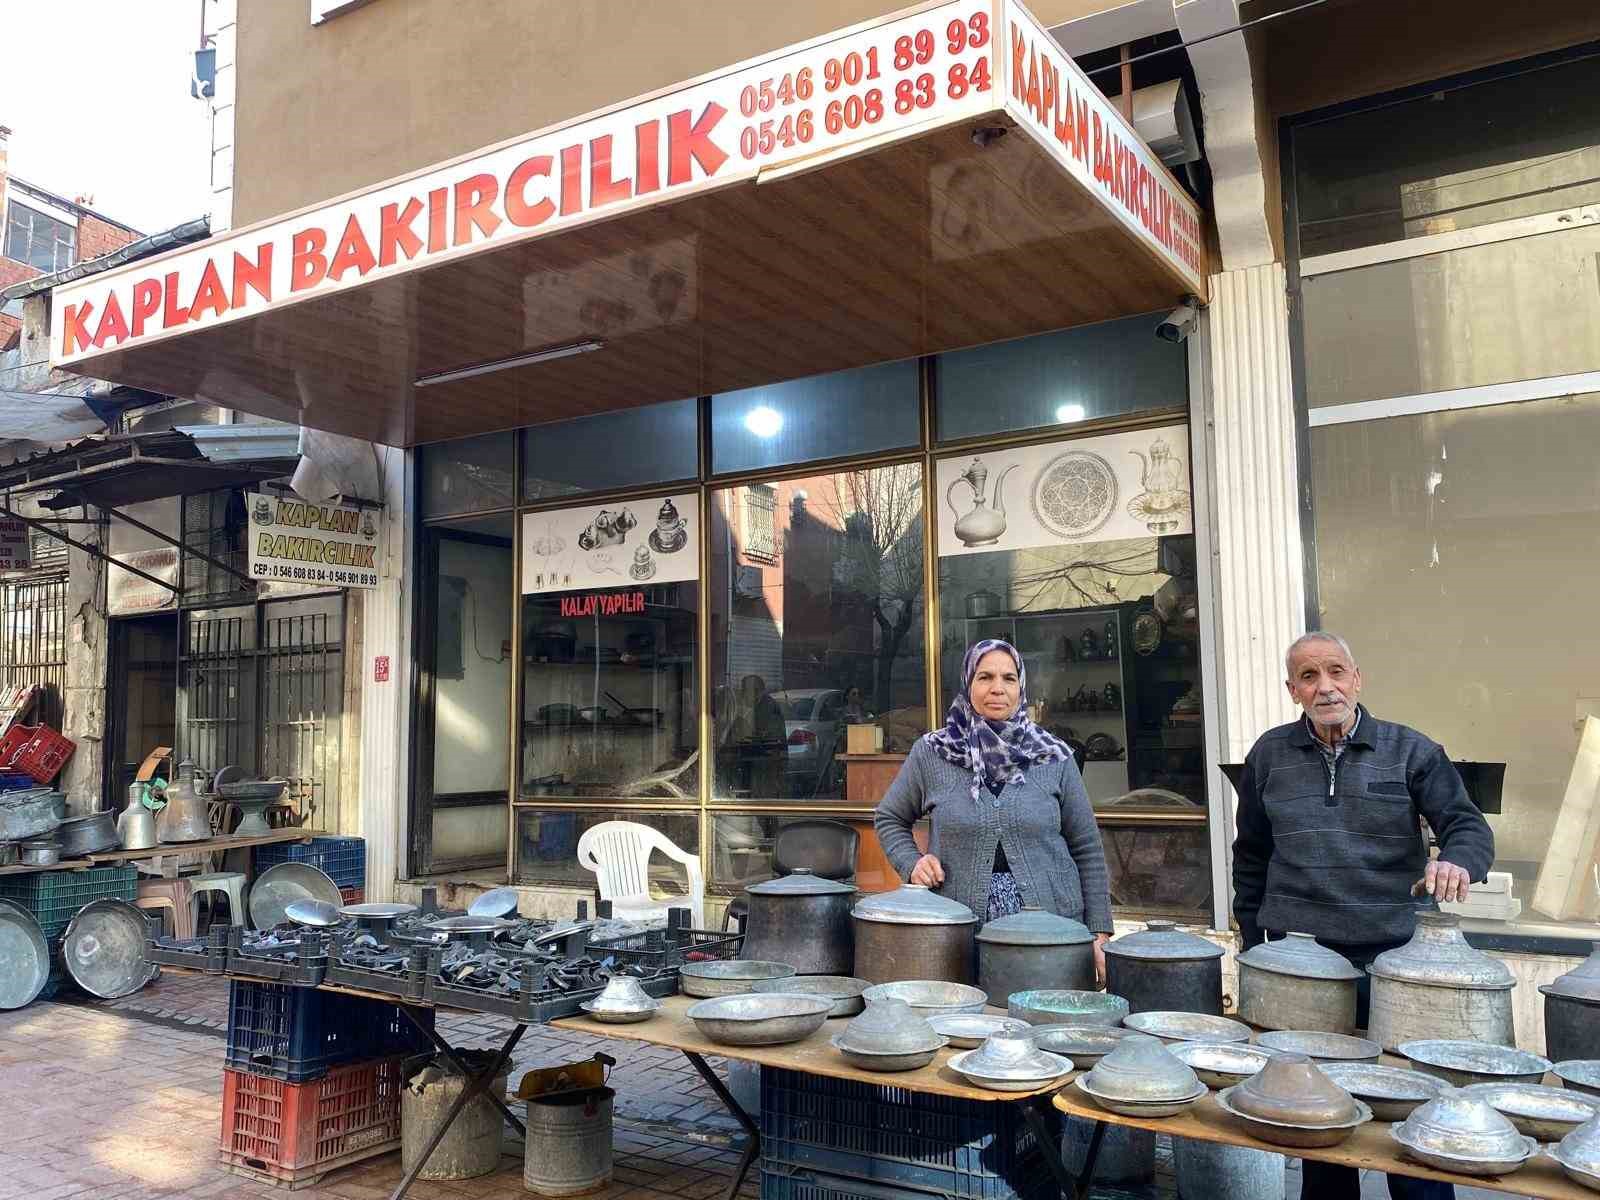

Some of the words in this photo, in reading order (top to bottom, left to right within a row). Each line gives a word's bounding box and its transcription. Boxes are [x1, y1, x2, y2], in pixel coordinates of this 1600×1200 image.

[740, 66, 814, 118] 0546
[824, 46, 881, 92] 901
[893, 29, 935, 71] 89
[946, 11, 990, 55] 93
[740, 108, 814, 160] 0546
[824, 88, 884, 135] 608
[894, 72, 936, 115] 83
[947, 55, 992, 100] 84
[1011, 20, 1089, 174] KAPLAN
[1092, 109, 1175, 255] BAKIRCILIK
[62, 242, 273, 357] KAPLAN
[290, 100, 730, 292] BAKIRCILIK
[257, 532, 376, 568] BAKIRCILIK
[275, 501, 361, 535] KAPLAN
[253, 563, 268, 575] CEP
[279, 565, 292, 578] 546
[293, 567, 306, 579] 608
[307, 568, 316, 580] 83
[334, 570, 347, 583] 546
[347, 572, 359, 585] 901
[360, 574, 369, 585] 89
[369, 575, 377, 586] 93
[561, 595, 597, 617] KALAY
[600, 592, 645, 615] YAPILIR
